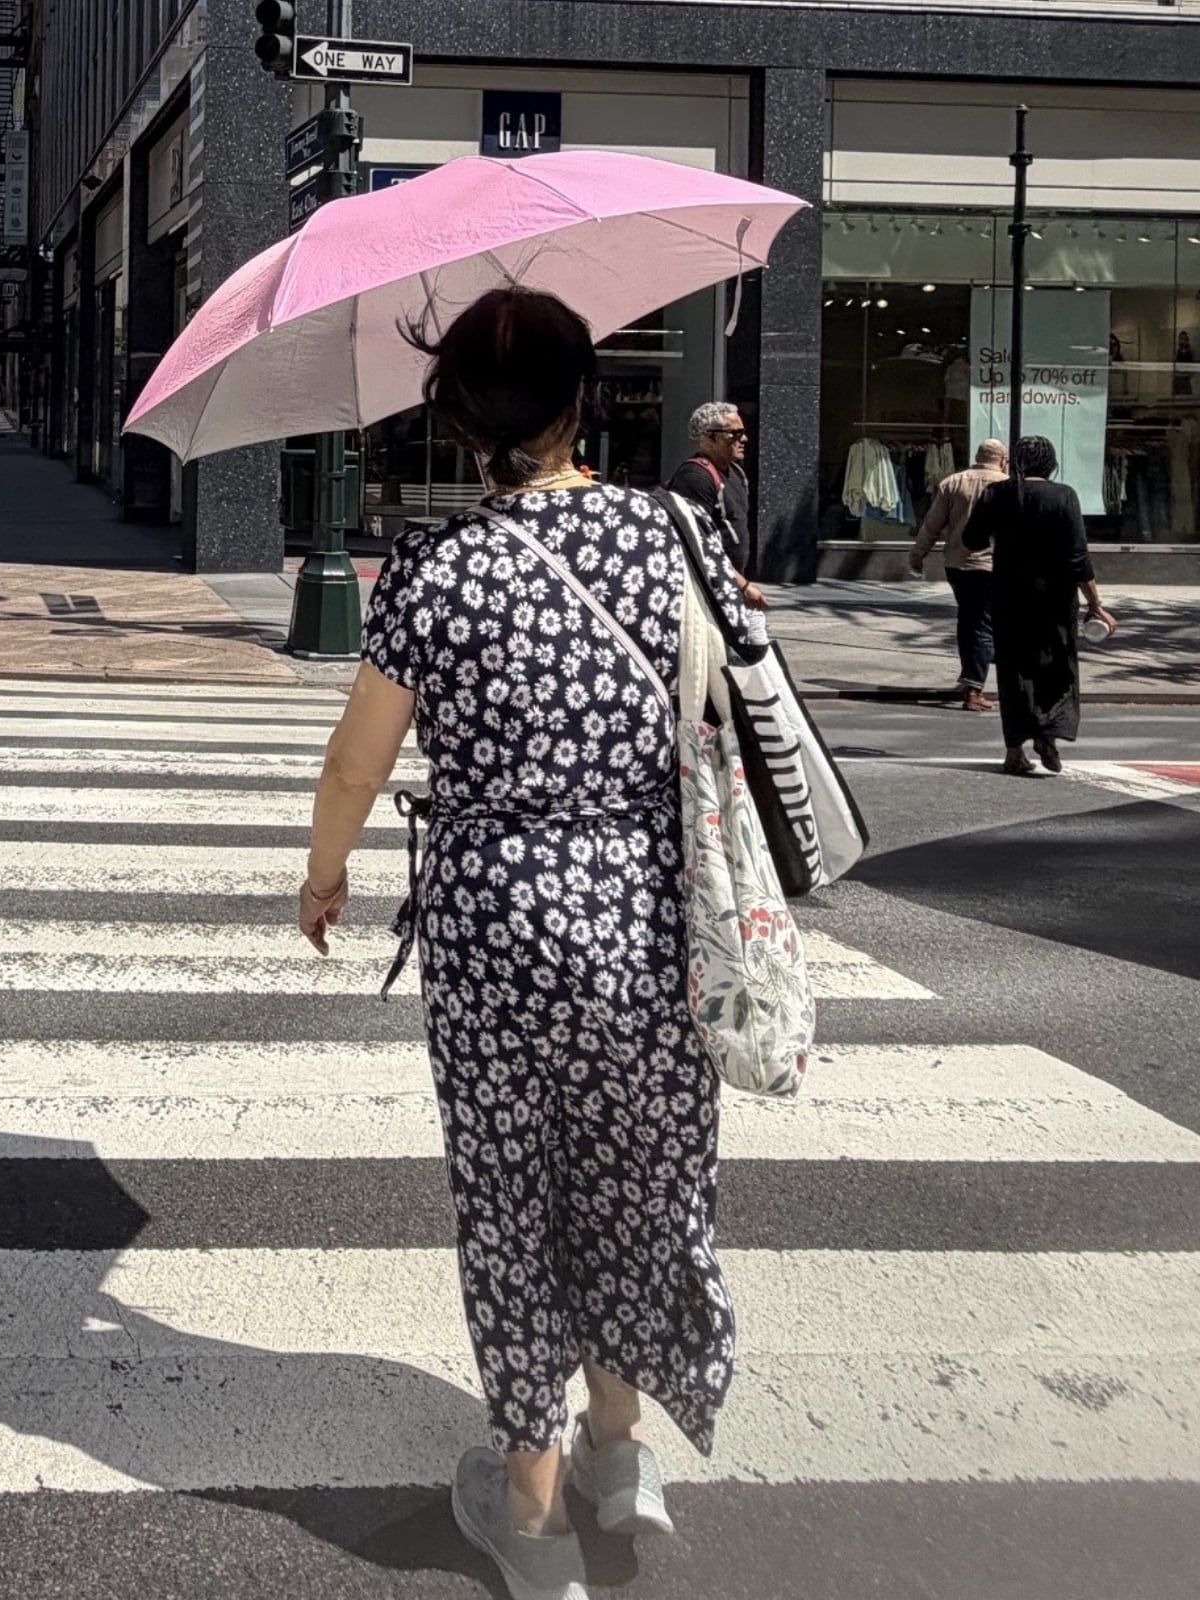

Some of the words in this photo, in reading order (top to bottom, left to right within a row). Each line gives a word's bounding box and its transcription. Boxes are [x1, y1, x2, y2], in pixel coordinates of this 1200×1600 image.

[313, 51, 346, 68] ONE
[362, 54, 396, 71] WAY
[499, 111, 546, 149] GAP
[980, 368, 1004, 388] Up
[1031, 368, 1069, 386] 70%
[1072, 369, 1097, 386] off
[979, 388, 1081, 406] mardowns.
